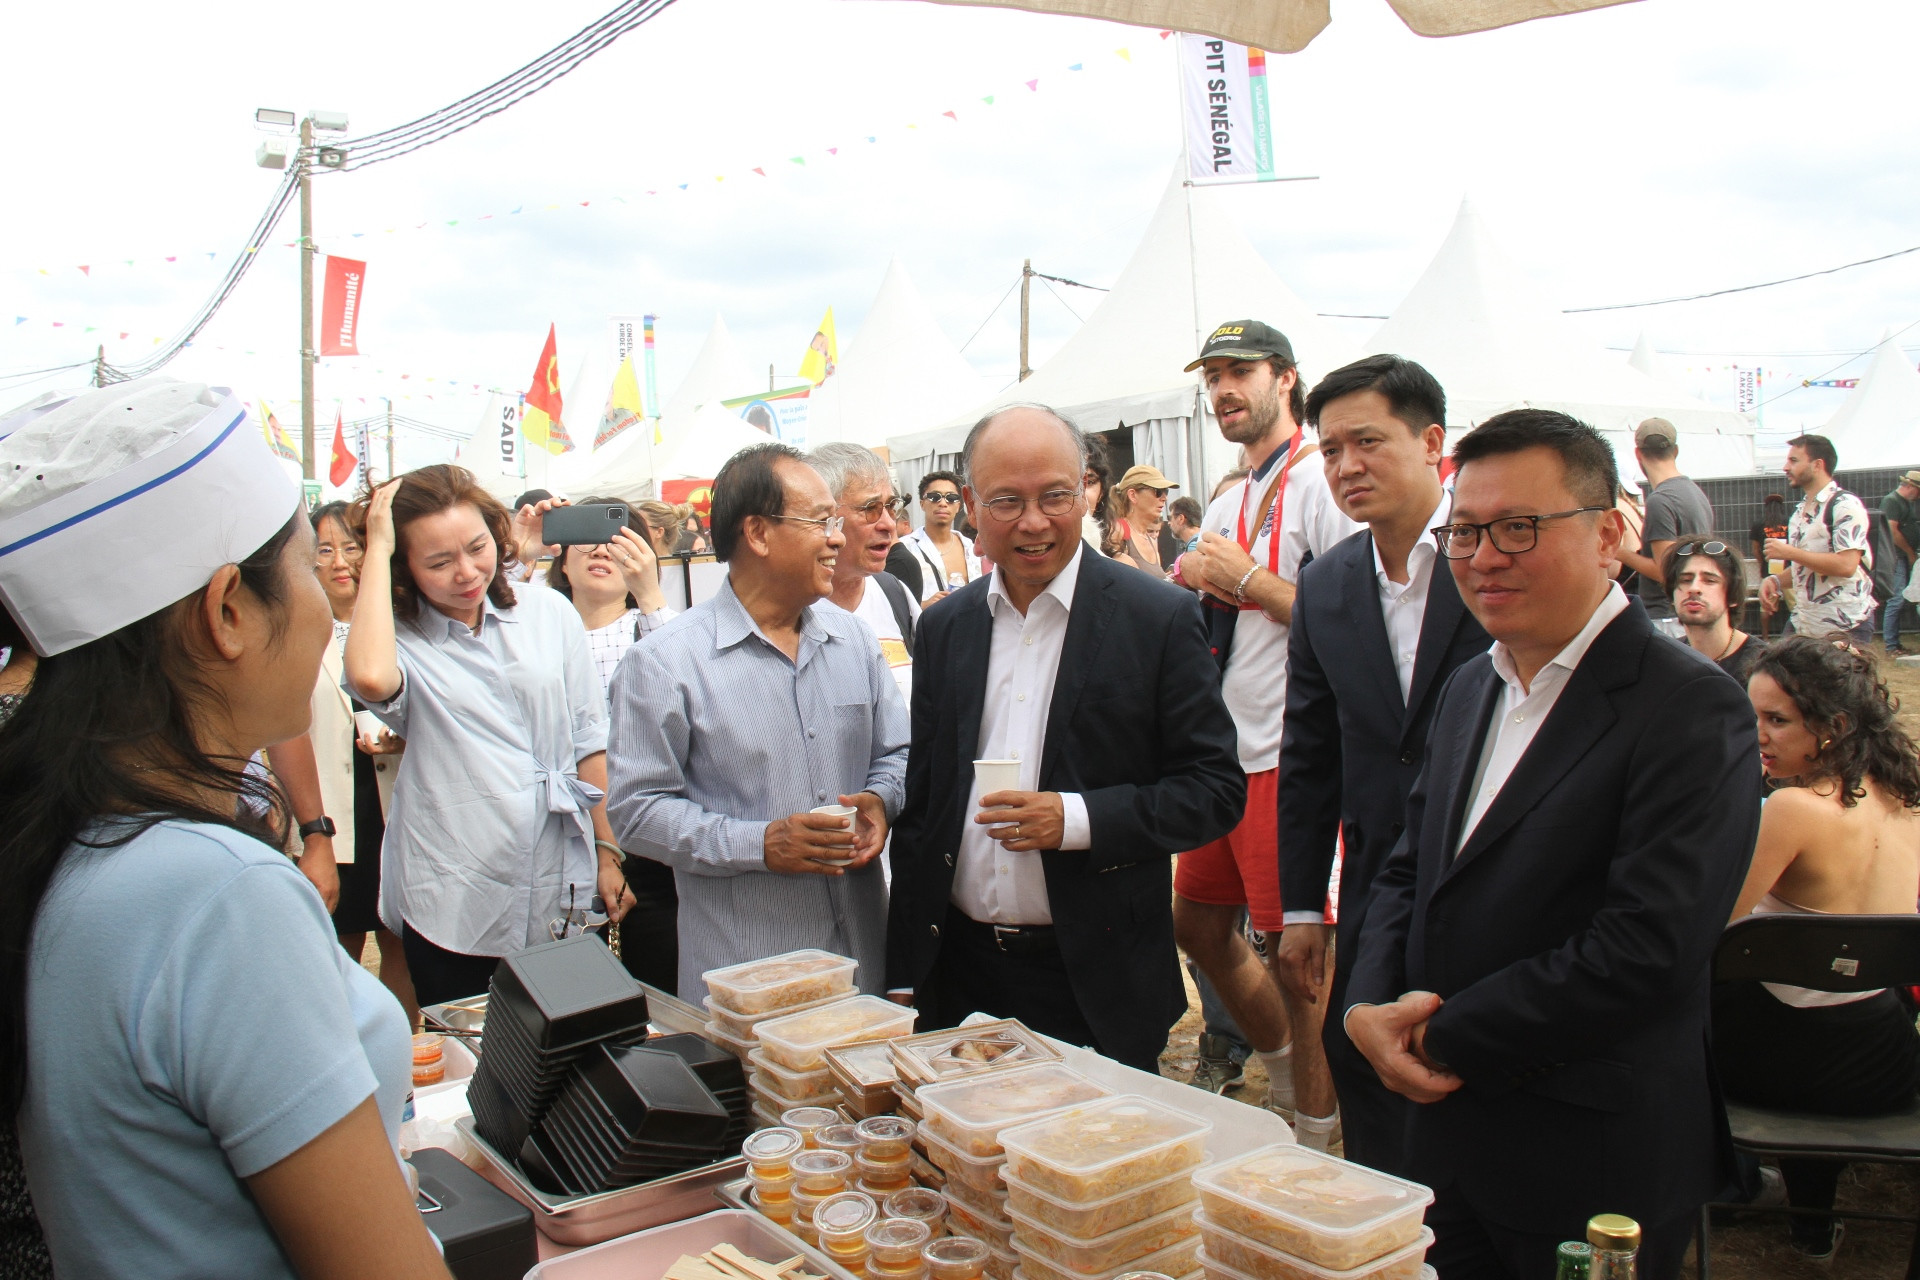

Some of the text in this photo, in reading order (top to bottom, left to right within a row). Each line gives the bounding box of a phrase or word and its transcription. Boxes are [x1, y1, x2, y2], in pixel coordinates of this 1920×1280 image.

[1207, 79, 1233, 173] SÉNÉGAL
[1746, 371, 1754, 405] KOUZEN
[501, 405, 515, 463] SADI
